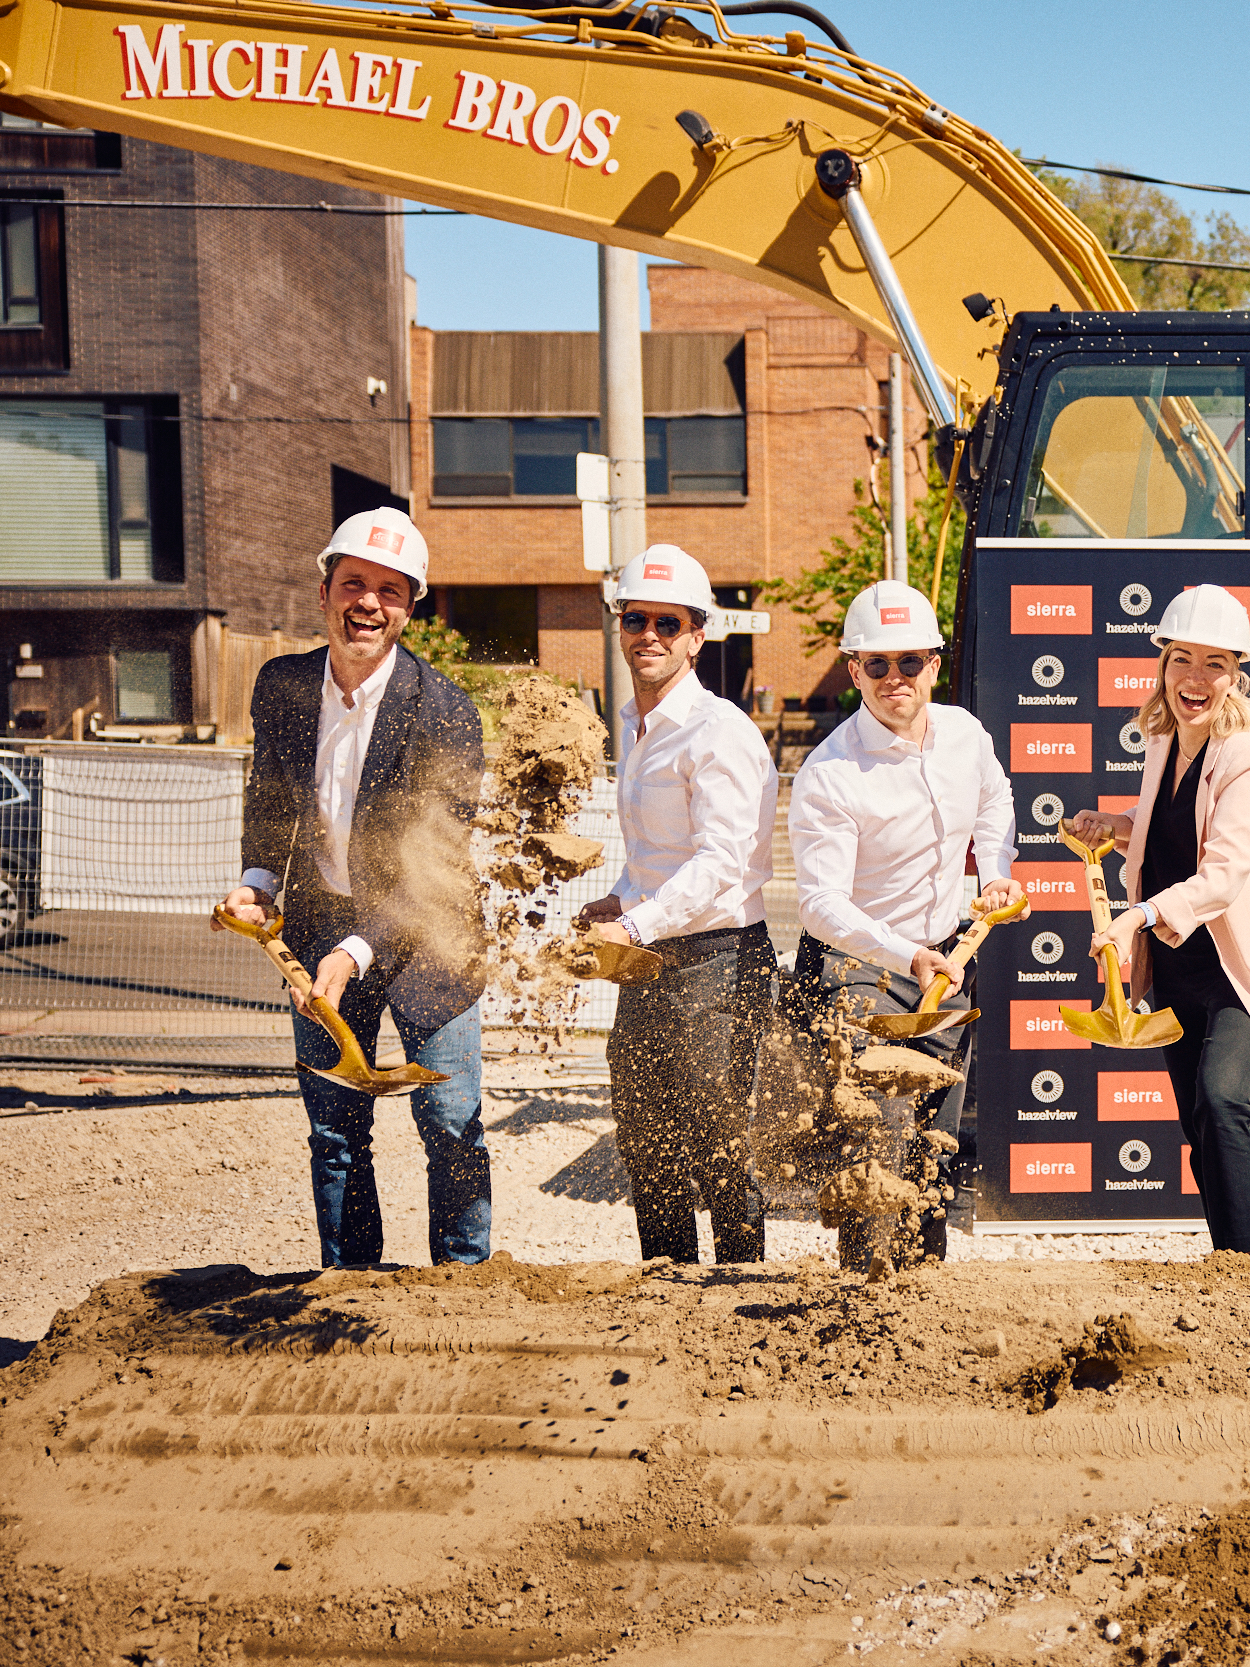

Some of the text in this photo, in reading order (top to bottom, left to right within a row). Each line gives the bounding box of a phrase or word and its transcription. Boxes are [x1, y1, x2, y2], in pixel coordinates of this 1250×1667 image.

[116, 23, 622, 174] MICHAEL BROS.
[372, 533, 399, 547] siea
[649, 568, 668, 576] sierra
[1026, 601, 1076, 617] sierra
[724, 614, 761, 629] AV. E.
[1018, 694, 1078, 706] hazelview
[1026, 740, 1076, 755] sierra
[1105, 760, 1146, 772] hazelv
[1017, 832, 1061, 844] hazelv
[1026, 879, 1076, 893] sierra
[1018, 971, 1078, 982] hazelview
[1026, 1017, 1069, 1031] sierr
[1114, 1089, 1163, 1103] sierra
[1018, 1109, 1078, 1121] hazelview
[1026, 1160, 1076, 1175] sierra
[1105, 1179, 1165, 1190] hazelview
